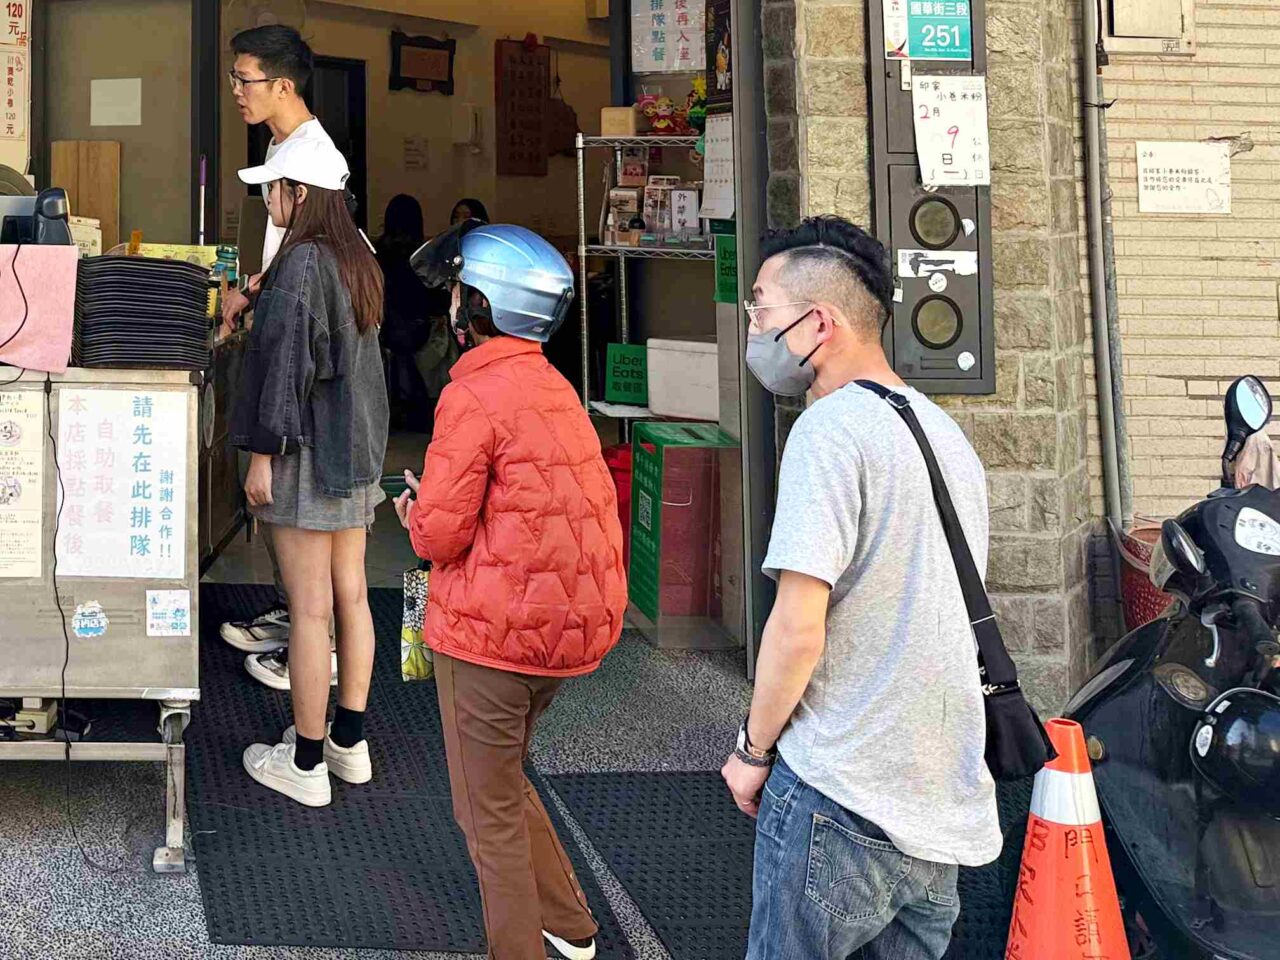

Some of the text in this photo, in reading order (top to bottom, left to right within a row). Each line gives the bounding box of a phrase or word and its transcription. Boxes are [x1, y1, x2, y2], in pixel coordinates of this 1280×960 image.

[910, 1, 969, 17] 國華街三段
[921, 24, 961, 47] 251
[612, 351, 643, 367] Uber
[612, 365, 644, 380] Eats
[91, 418, 115, 524] 自助取餐
[129, 395, 154, 558] 請先在此排隊
